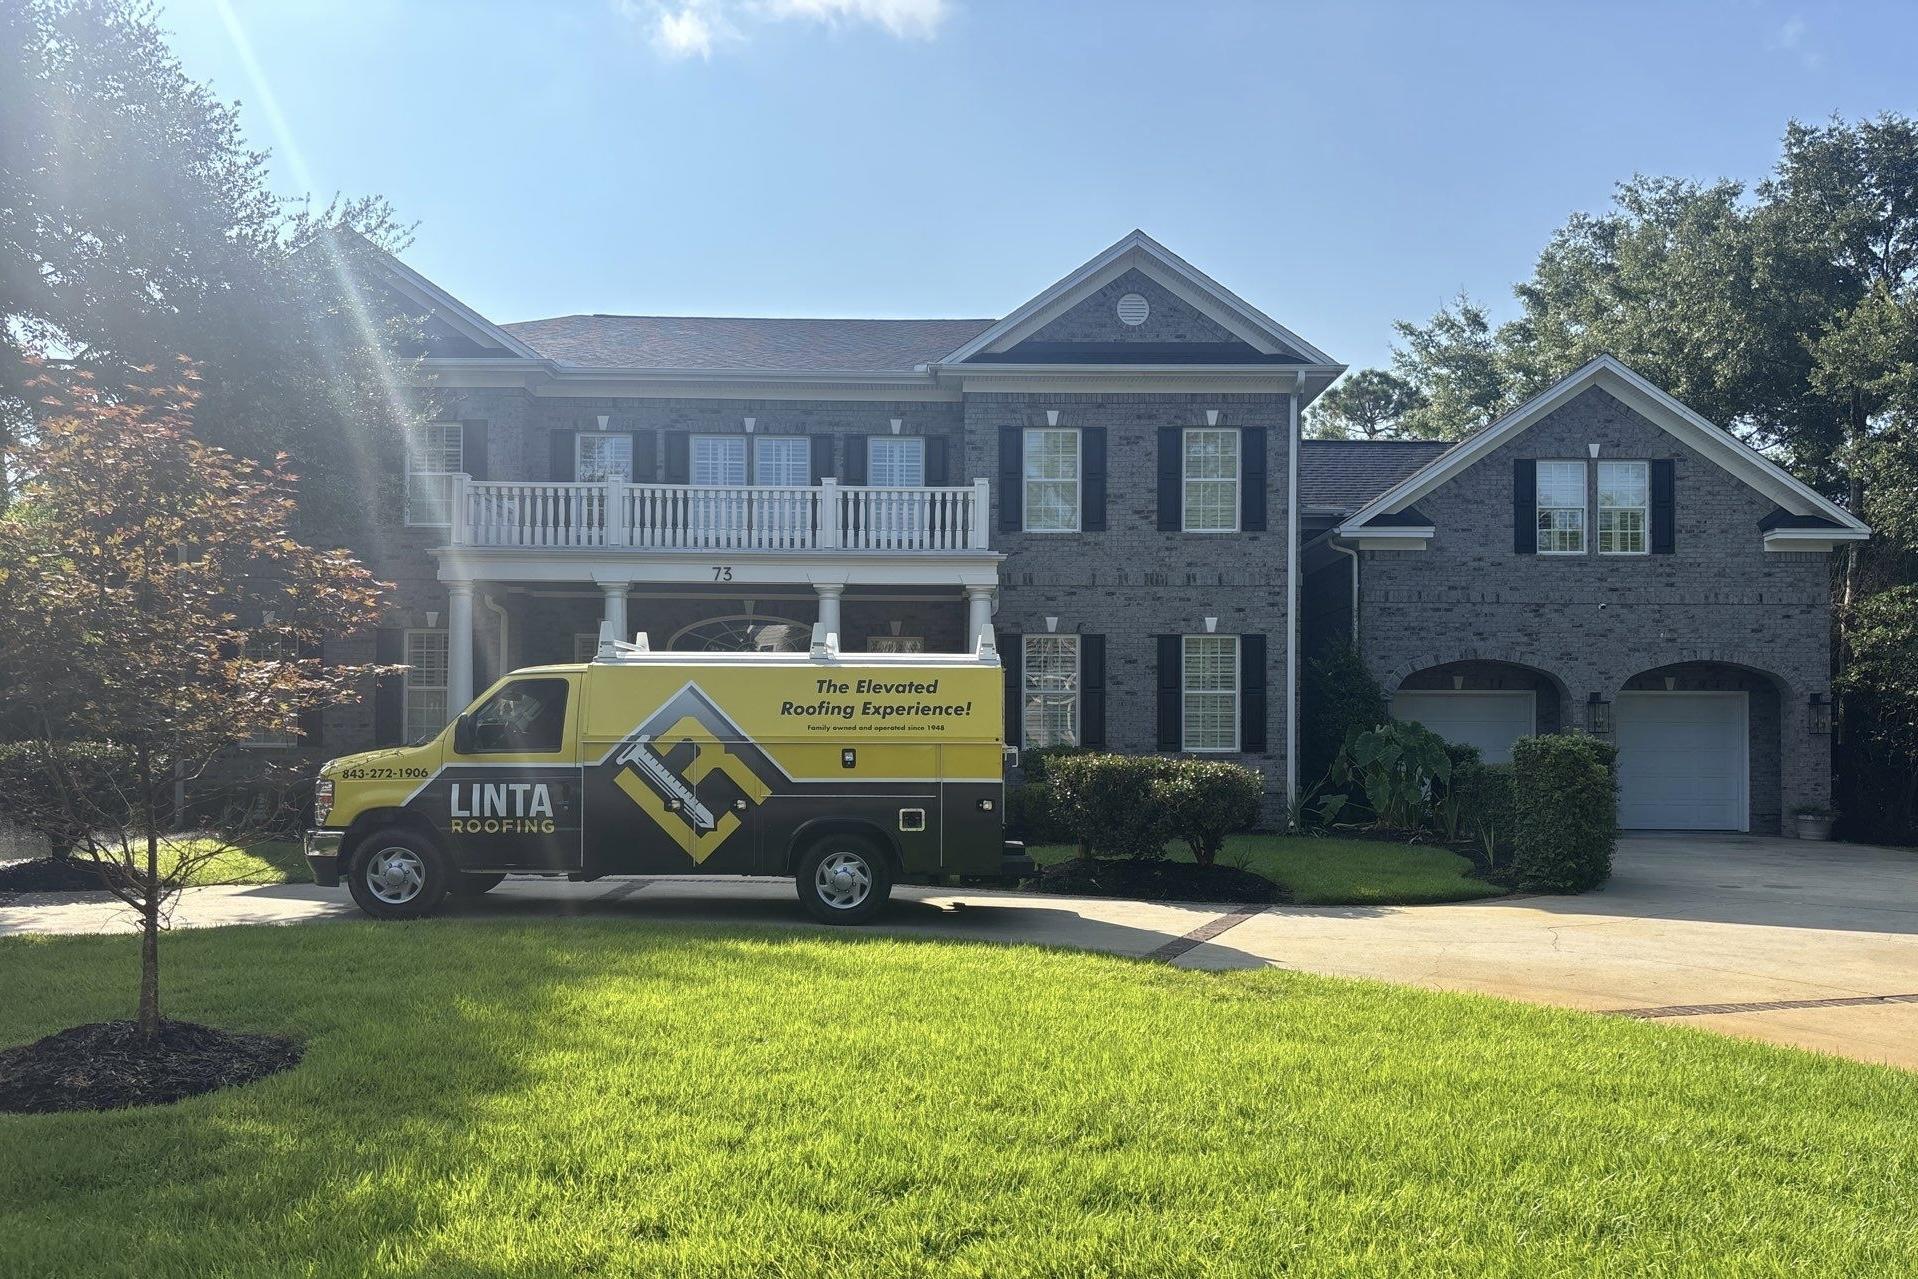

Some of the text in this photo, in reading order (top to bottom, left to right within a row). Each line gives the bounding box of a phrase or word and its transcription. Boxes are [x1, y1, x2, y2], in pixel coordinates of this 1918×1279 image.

[712, 567, 732, 581] 73
[816, 679, 938, 694] The Elevated
[781, 701, 972, 719] Roofing Experience!
[807, 724, 830, 732] Family
[874, 724, 905, 732] operated
[342, 767, 428, 779] 843-272-1906
[450, 783, 554, 817] LINTA
[450, 819, 555, 834] ROOFING
